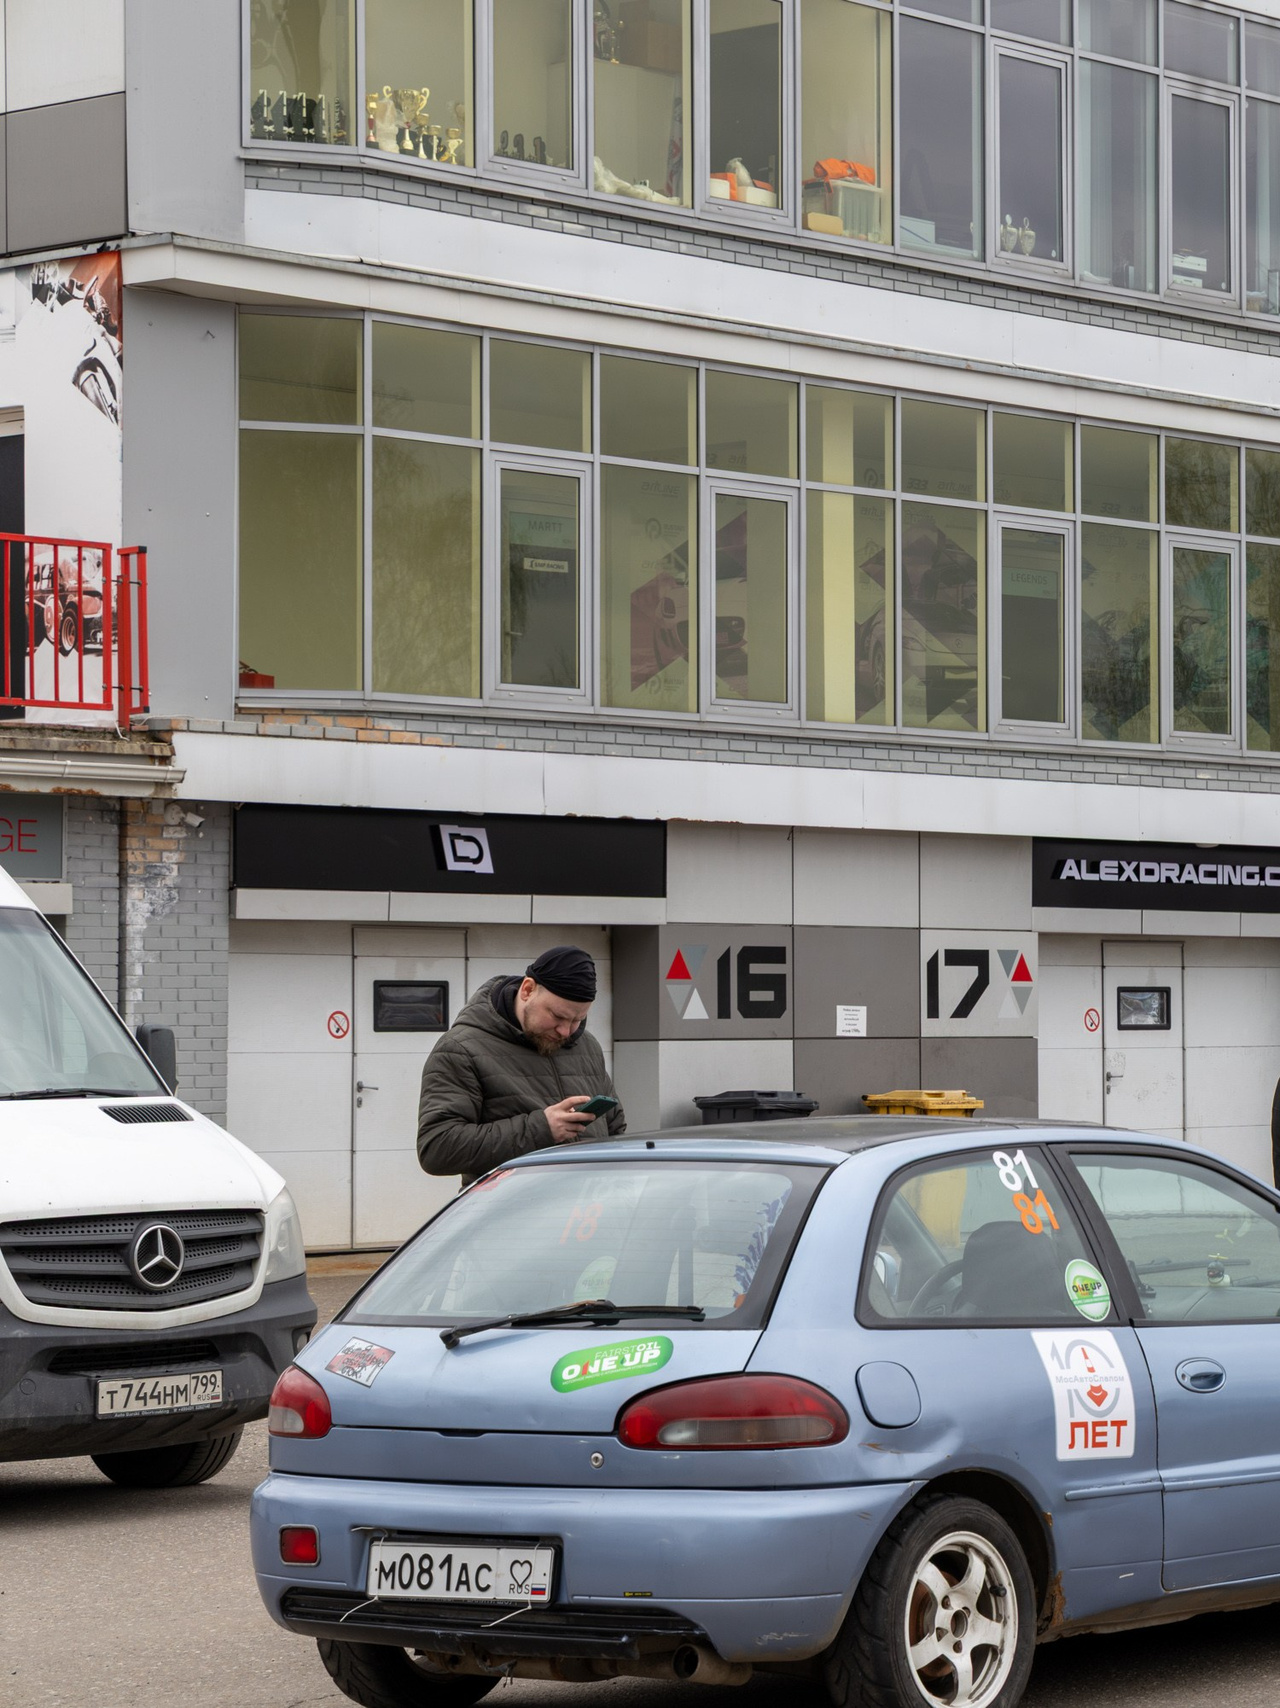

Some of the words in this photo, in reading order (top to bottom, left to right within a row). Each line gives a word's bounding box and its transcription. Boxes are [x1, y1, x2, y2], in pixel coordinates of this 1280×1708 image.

[1010, 572, 1048, 585] LEGENDS
[717, 946, 787, 1019] 16
[927, 948, 990, 1019] 17
[992, 1149, 1039, 1192] 81
[1012, 1188, 1060, 1235] 81
[1071, 1283, 1091, 1293] ONE
[1090, 1281, 1102, 1291] UP
[561, 1356, 619, 1381] ONE
[621, 1348, 661, 1368] UP
[1055, 1374, 1125, 1384] МосАвтоСлалом
[106, 1380, 188, 1410] Т744НМ
[191, 1373, 218, 1395] 799
[197, 1394, 211, 1402] RUS
[1068, 1420, 1128, 1450] ЛЕТ
[378, 1552, 493, 1593] М081АС
[508, 1583, 531, 1595] RUS
